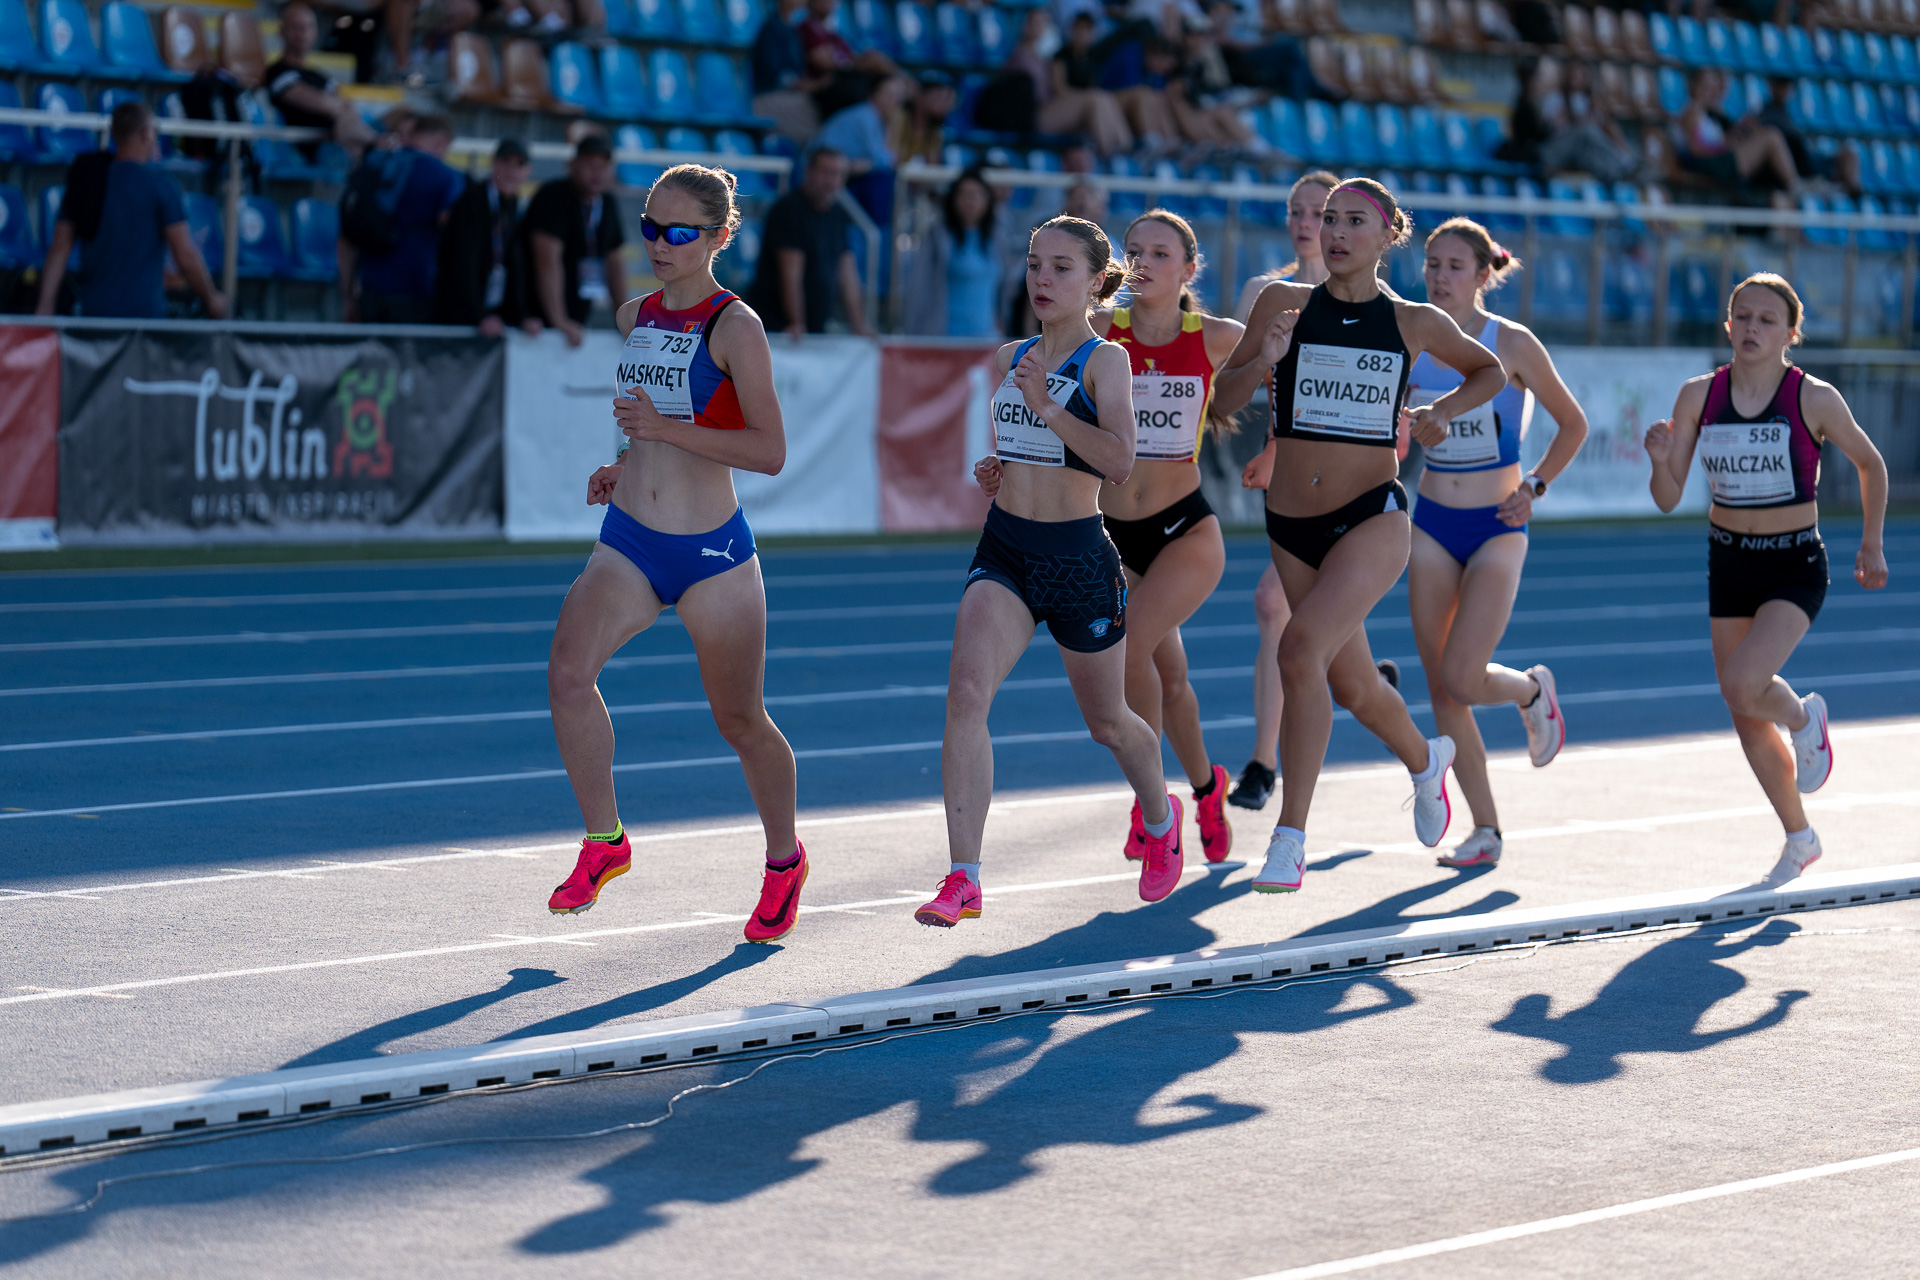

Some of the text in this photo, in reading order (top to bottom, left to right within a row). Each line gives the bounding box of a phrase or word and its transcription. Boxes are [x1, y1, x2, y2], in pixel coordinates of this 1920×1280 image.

[660, 335, 693, 354] 732
[1356, 354, 1393, 373] 682
[617, 363, 687, 391] NASKRĘT
[1160, 382, 1195, 398] 288
[1299, 378, 1391, 405] GWIAZDA
[993, 402, 1048, 429] LIGENZ
[1134, 410, 1182, 429] ROC
[1448, 419, 1484, 438] TEK
[1749, 427, 1780, 443] 558
[1703, 454, 1786, 473] WALCZAK
[1740, 535, 1793, 550] NIKE
